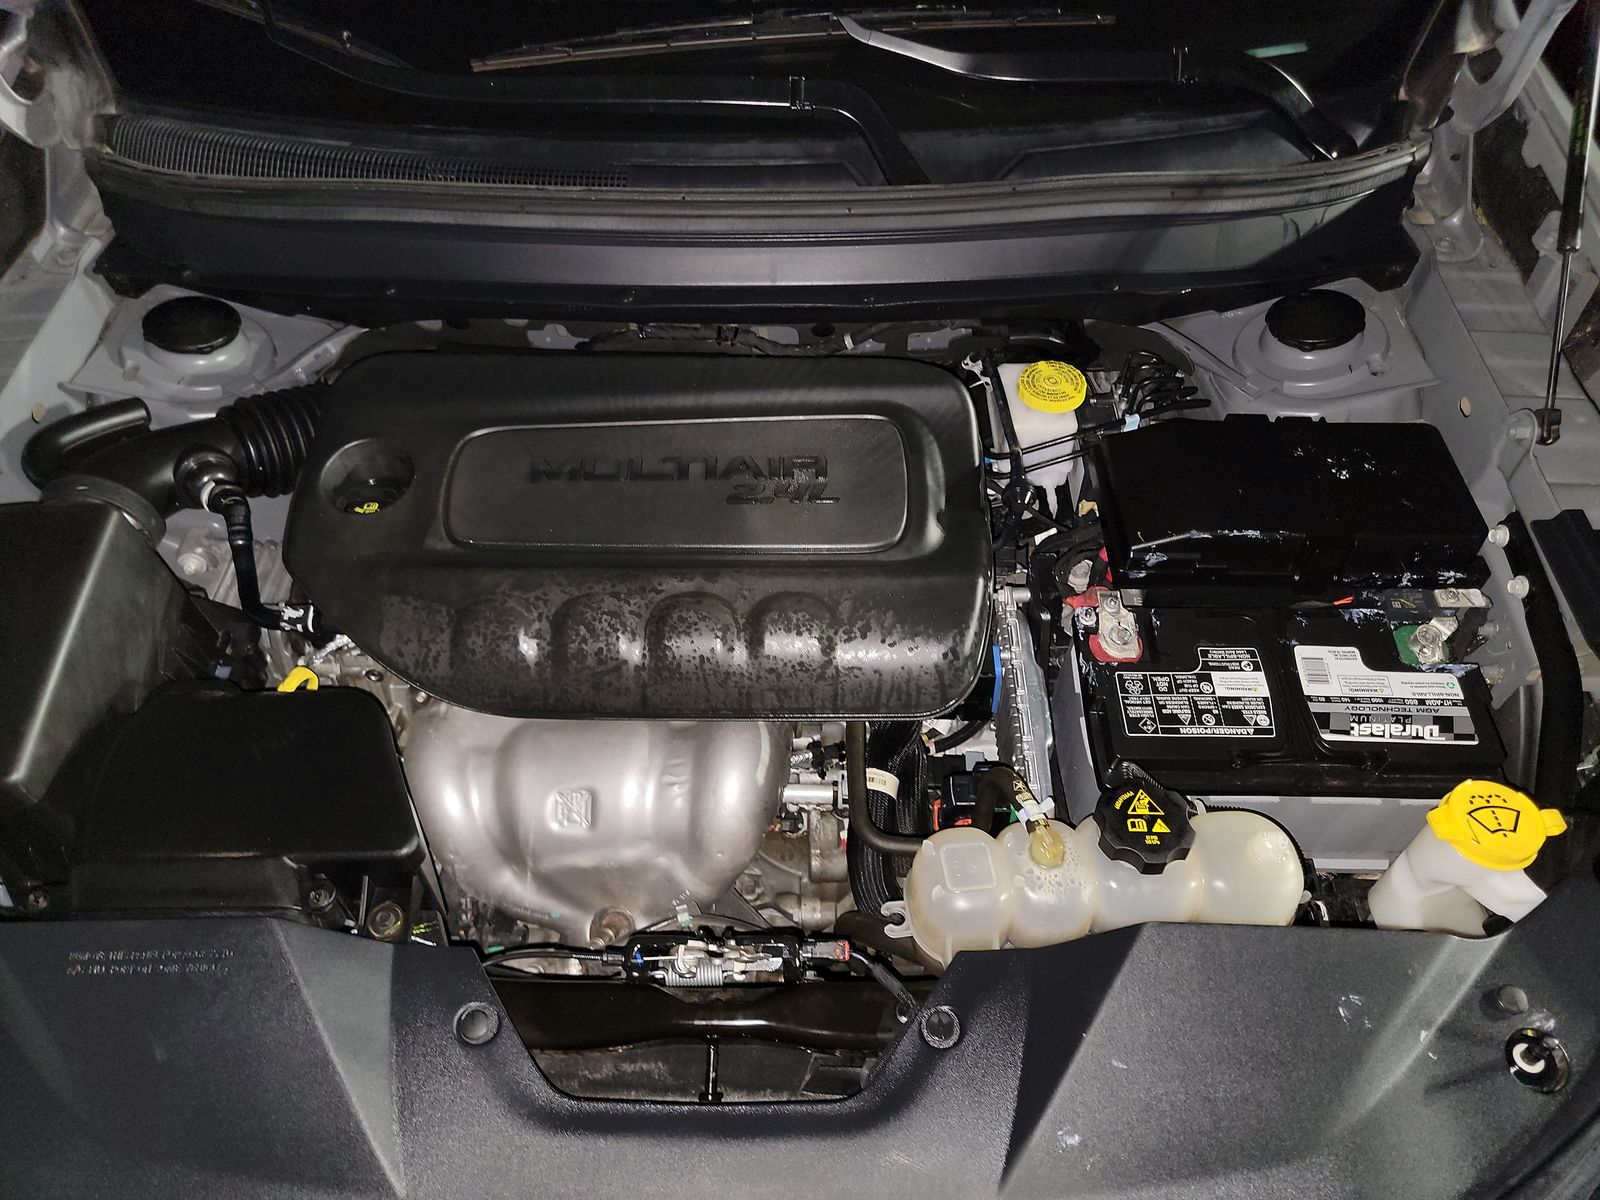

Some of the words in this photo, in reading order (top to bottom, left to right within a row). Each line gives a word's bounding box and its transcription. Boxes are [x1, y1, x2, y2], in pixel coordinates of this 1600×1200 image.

[528, 455, 829, 482] MULTIAIR
[1350, 715, 1412, 723] PLATINUM
[1179, 727, 1247, 735] DANGER/POISON
[1350, 723, 1445, 740] Duralast
